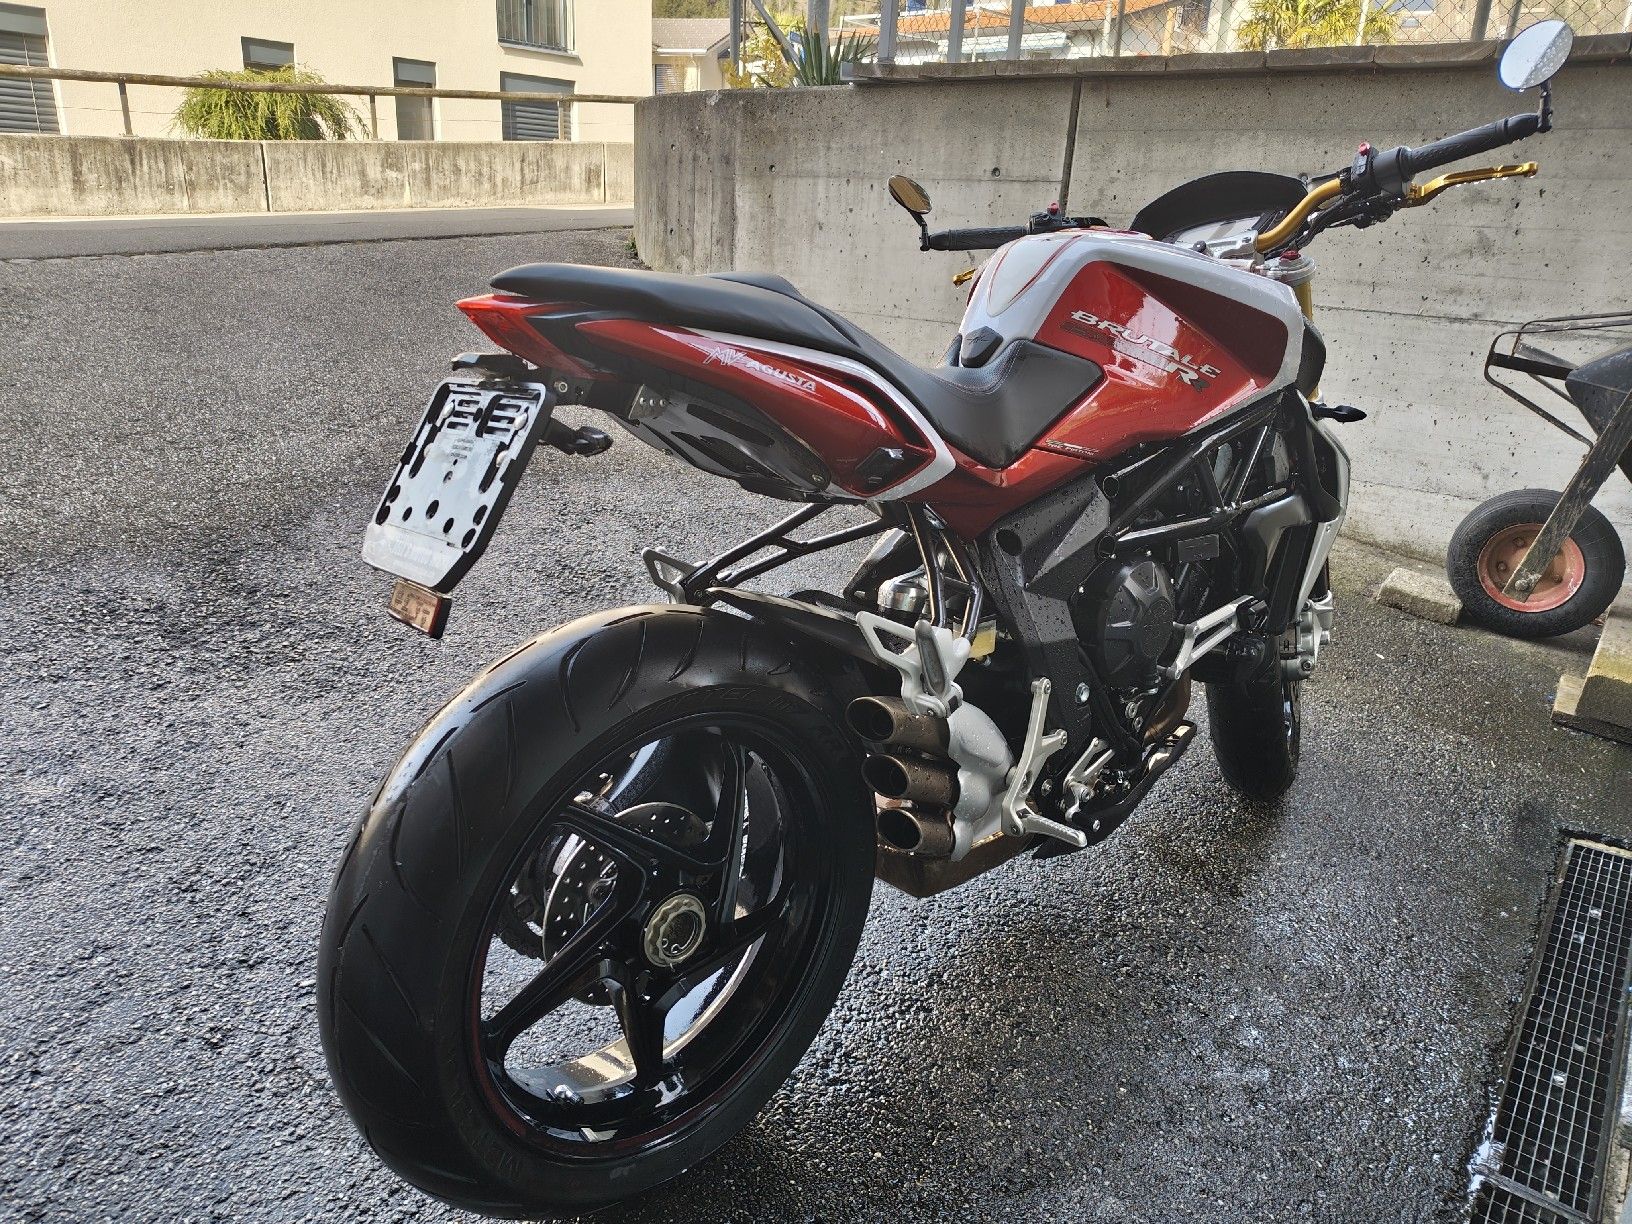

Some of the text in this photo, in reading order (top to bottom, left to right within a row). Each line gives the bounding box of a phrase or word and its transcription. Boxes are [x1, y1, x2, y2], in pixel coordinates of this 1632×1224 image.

[703, 347, 817, 392] MV AGUSTA
[1070, 310, 1222, 379] BRUTALE
